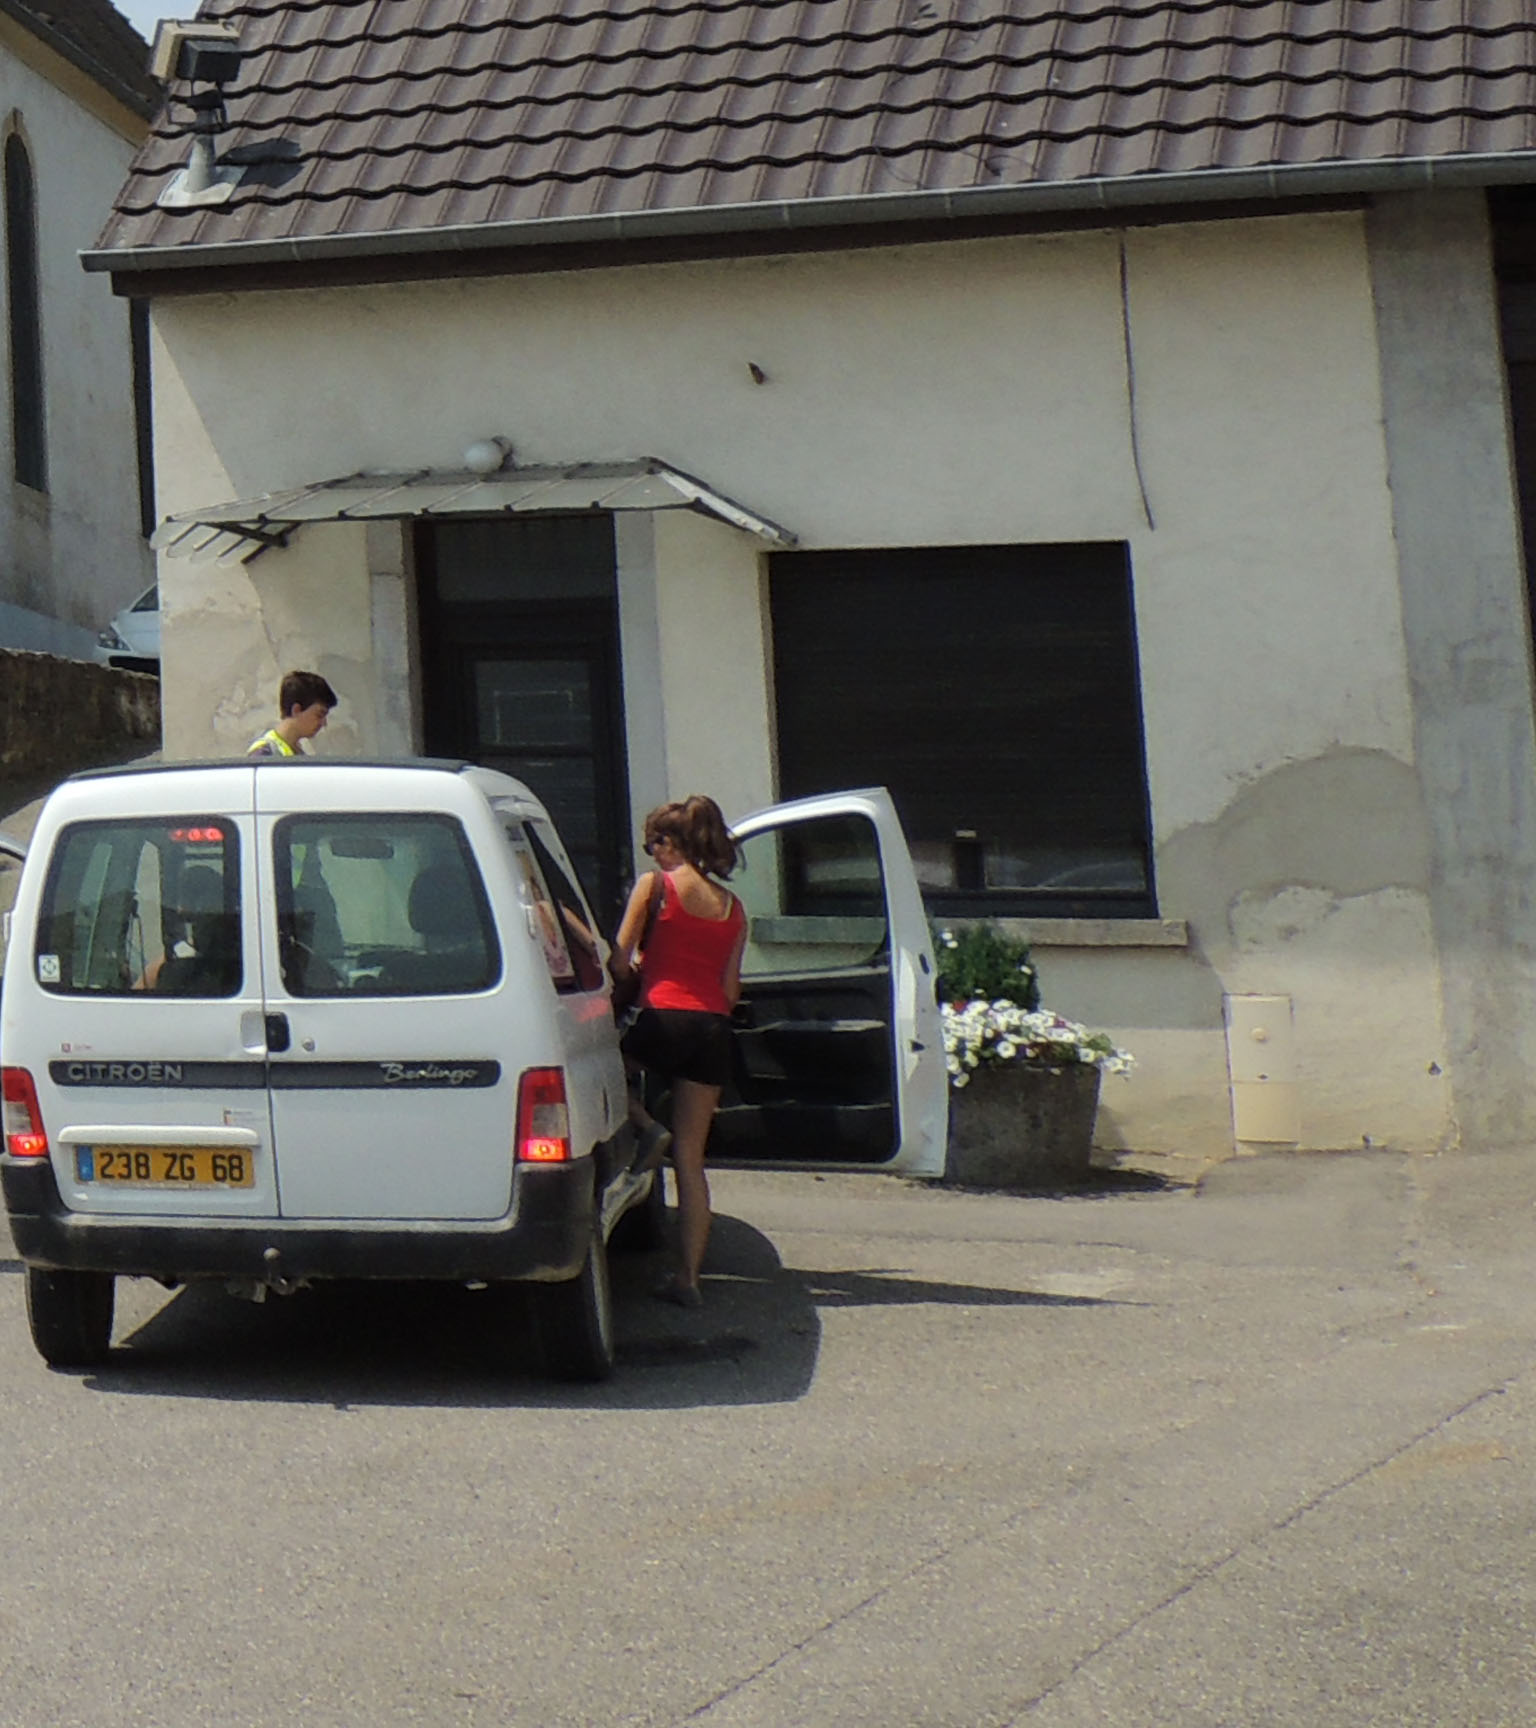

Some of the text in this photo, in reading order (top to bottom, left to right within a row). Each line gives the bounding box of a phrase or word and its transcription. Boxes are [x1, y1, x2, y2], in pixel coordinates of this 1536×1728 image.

[67, 1061, 183, 1082] CITROËN
[380, 1062, 478, 1085] Berlingo
[99, 1152, 244, 1182] 238 ZG 68
